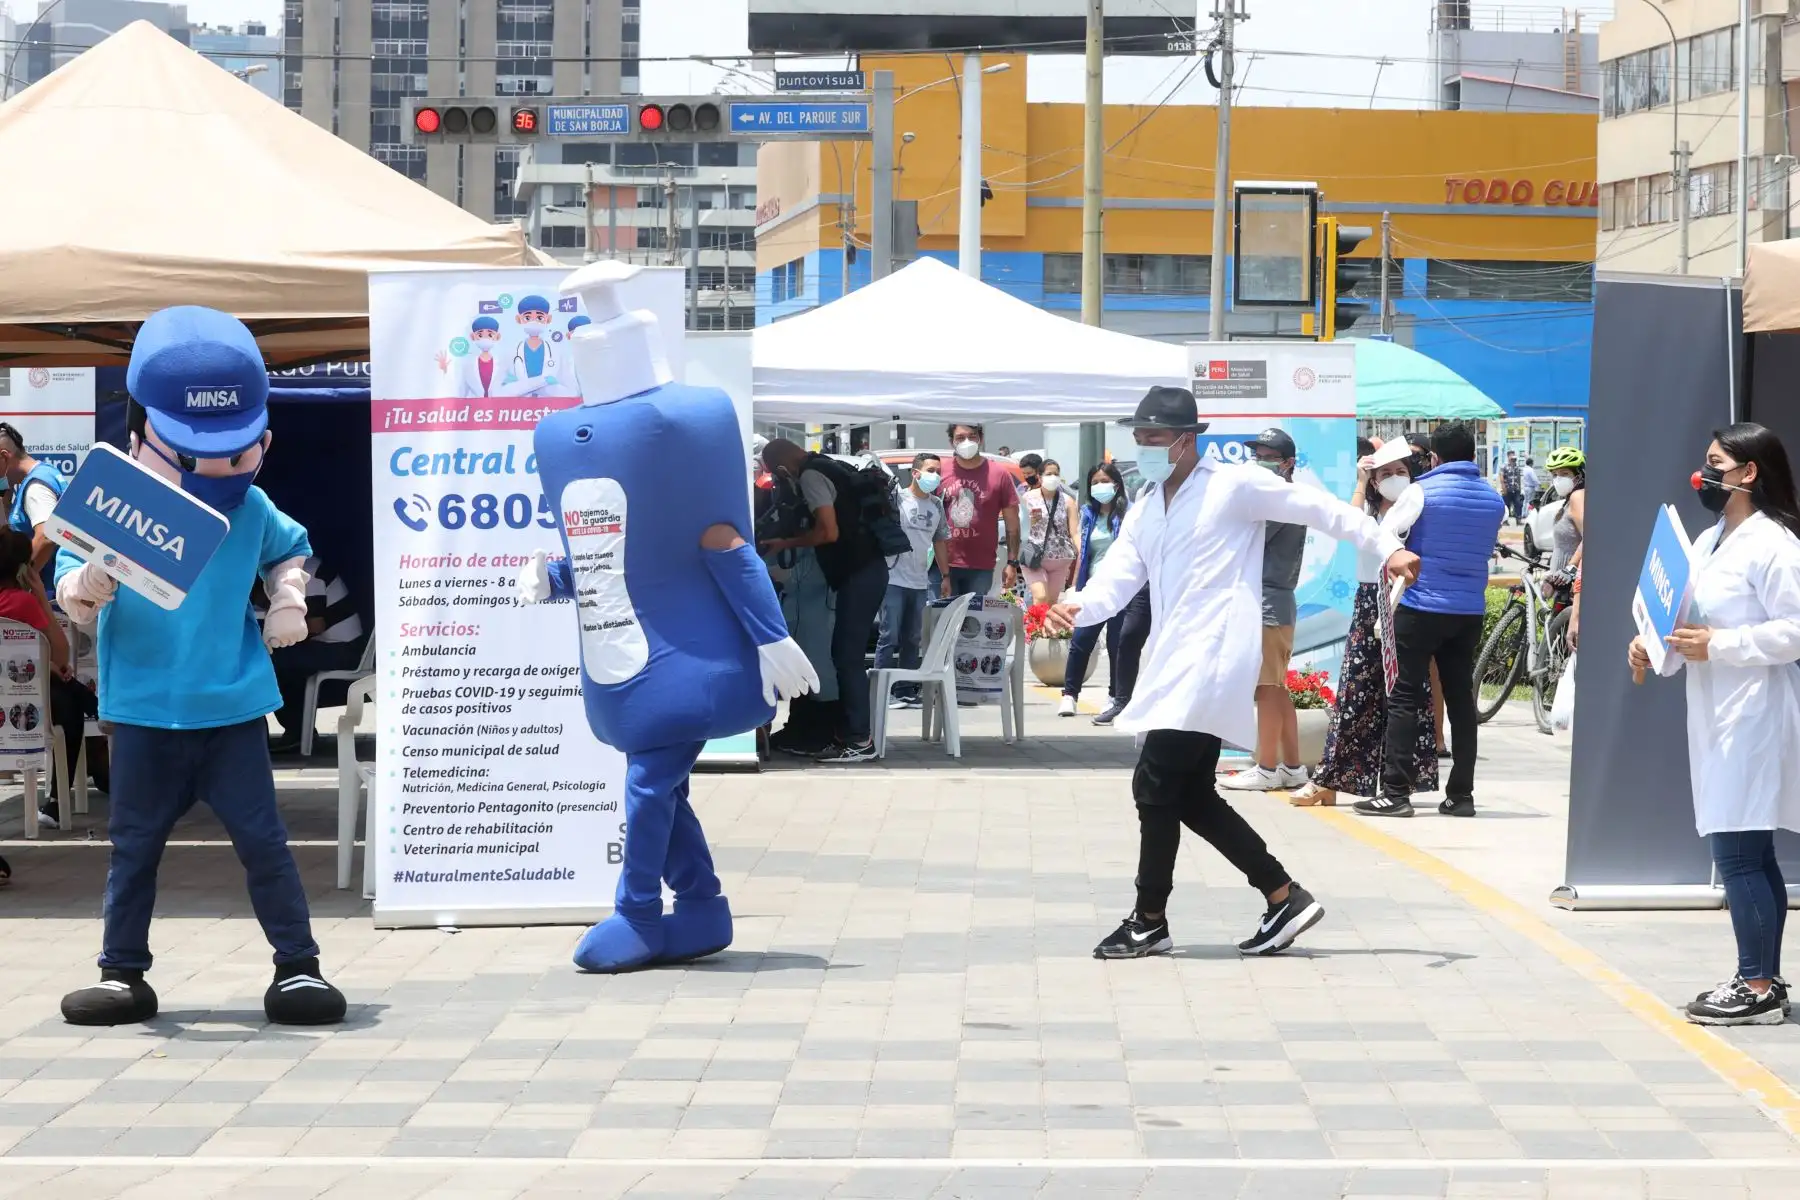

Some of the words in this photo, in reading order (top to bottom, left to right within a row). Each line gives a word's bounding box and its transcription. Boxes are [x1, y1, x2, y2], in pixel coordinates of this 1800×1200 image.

[778, 74, 861, 88] puntovisual
[553, 108, 623, 119] MUNICIPALIDAD
[758, 112, 773, 124] AV.
[777, 112, 795, 124] DEL
[800, 112, 837, 124] PARQUE
[842, 111, 861, 124] SUR
[516, 113, 534, 129] 36
[555, 120, 566, 131] DE
[569, 120, 588, 131] SAN
[591, 120, 622, 131] BORJA
[1444, 177, 1534, 205] TODO
[186, 390, 239, 408] MINSA
[384, 407, 413, 429] ¡Tu
[417, 405, 470, 424] salud
[473, 410, 494, 423] es
[55, 443, 66, 451] de
[69, 443, 90, 451] Salud
[389, 444, 516, 477] Central
[437, 493, 559, 530] 6805
[564, 510, 579, 526] NO
[580, 508, 609, 519] bajemos
[85, 485, 185, 561] MINSA
[582, 517, 589, 526] la
[591, 513, 621, 527] guardia
[399, 553, 462, 569] Horario
[466, 552, 487, 568] de
[399, 578, 431, 589] Lunes
[434, 580, 441, 588] a
[444, 577, 488, 588] viernes
[497, 576, 506, 587] 8
[508, 579, 516, 587] a
[1648, 547, 1674, 617] MINSA
[398, 595, 450, 607] Sábados,
[453, 595, 511, 608] domingos
[512, 597, 520, 607] y
[399, 621, 481, 638] Servicios:
[402, 644, 477, 657] Ambulancia
[402, 666, 460, 678] Préstamo
[463, 668, 471, 679] y
[473, 667, 520, 679] recarga
[523, 664, 538, 676] de
[402, 687, 451, 699] Pruebas
[455, 686, 516, 698] COVID-19
[518, 689, 526, 700] y
[528, 685, 583, 699] seguimie
[402, 703, 417, 715] de
[419, 705, 453, 715] casos
[455, 702, 512, 716] positivos
[402, 724, 474, 736] Vacunación
[477, 724, 510, 736] (Niños
[512, 726, 519, 736] y
[520, 723, 564, 735] adultos)
[402, 746, 438, 757] Censo
[441, 744, 505, 759] municipal
[507, 744, 522, 755] de
[525, 744, 560, 755] salud
[403, 767, 490, 779] Telemedicina:
[402, 782, 454, 794] Nutrición,
[457, 781, 504, 792] Medicina
[506, 781, 549, 792] General,
[552, 780, 606, 793] Psicología
[402, 802, 475, 814] Preventorio
[477, 801, 554, 815] Pentagonito
[556, 801, 618, 814] (presencial)
[403, 824, 444, 836] Centro
[447, 823, 462, 835] de
[465, 822, 553, 835] rehabilitación
[403, 843, 474, 855] Veterinaria
[476, 842, 540, 856] municipal
[393, 867, 576, 884] #NaturalmenteSaludable
